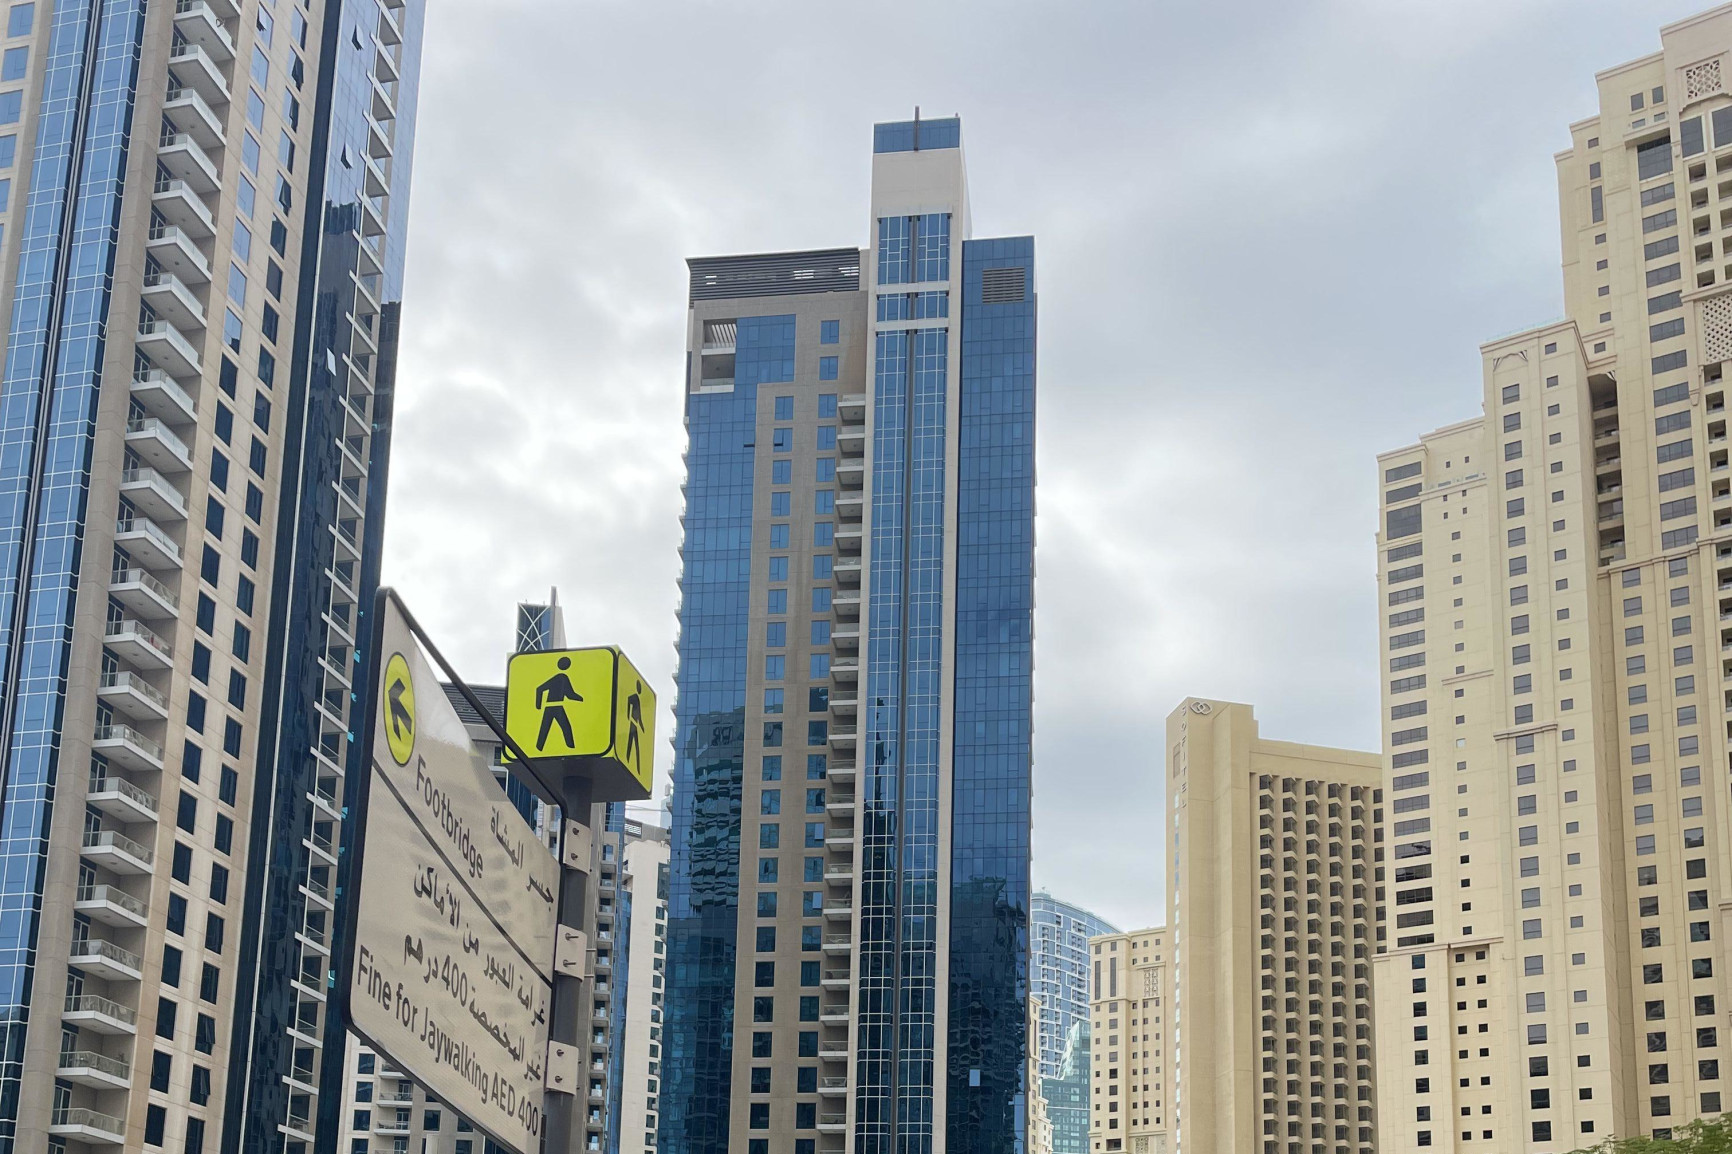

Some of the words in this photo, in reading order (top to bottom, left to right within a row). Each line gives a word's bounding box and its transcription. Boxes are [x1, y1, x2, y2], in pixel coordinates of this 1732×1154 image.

[416, 753, 484, 879] Footbridge
[490, 805, 524, 870] المشاة
[413, 864, 461, 929] الأماكن
[526, 873, 554, 913] جسر
[462, 923, 479, 956] من
[441, 954, 468, 1007] 400
[483, 953, 515, 992] العبور
[468, 985, 525, 1064] المخصصة
[517, 973, 546, 1027] غرامة
[357, 944, 392, 1011] Fine
[395, 982, 418, 1033] for
[419, 1006, 489, 1105] Jaywalking
[490, 1071, 516, 1118] AED
[517, 1095, 540, 1137] 400
[523, 1054, 541, 1082] غير
